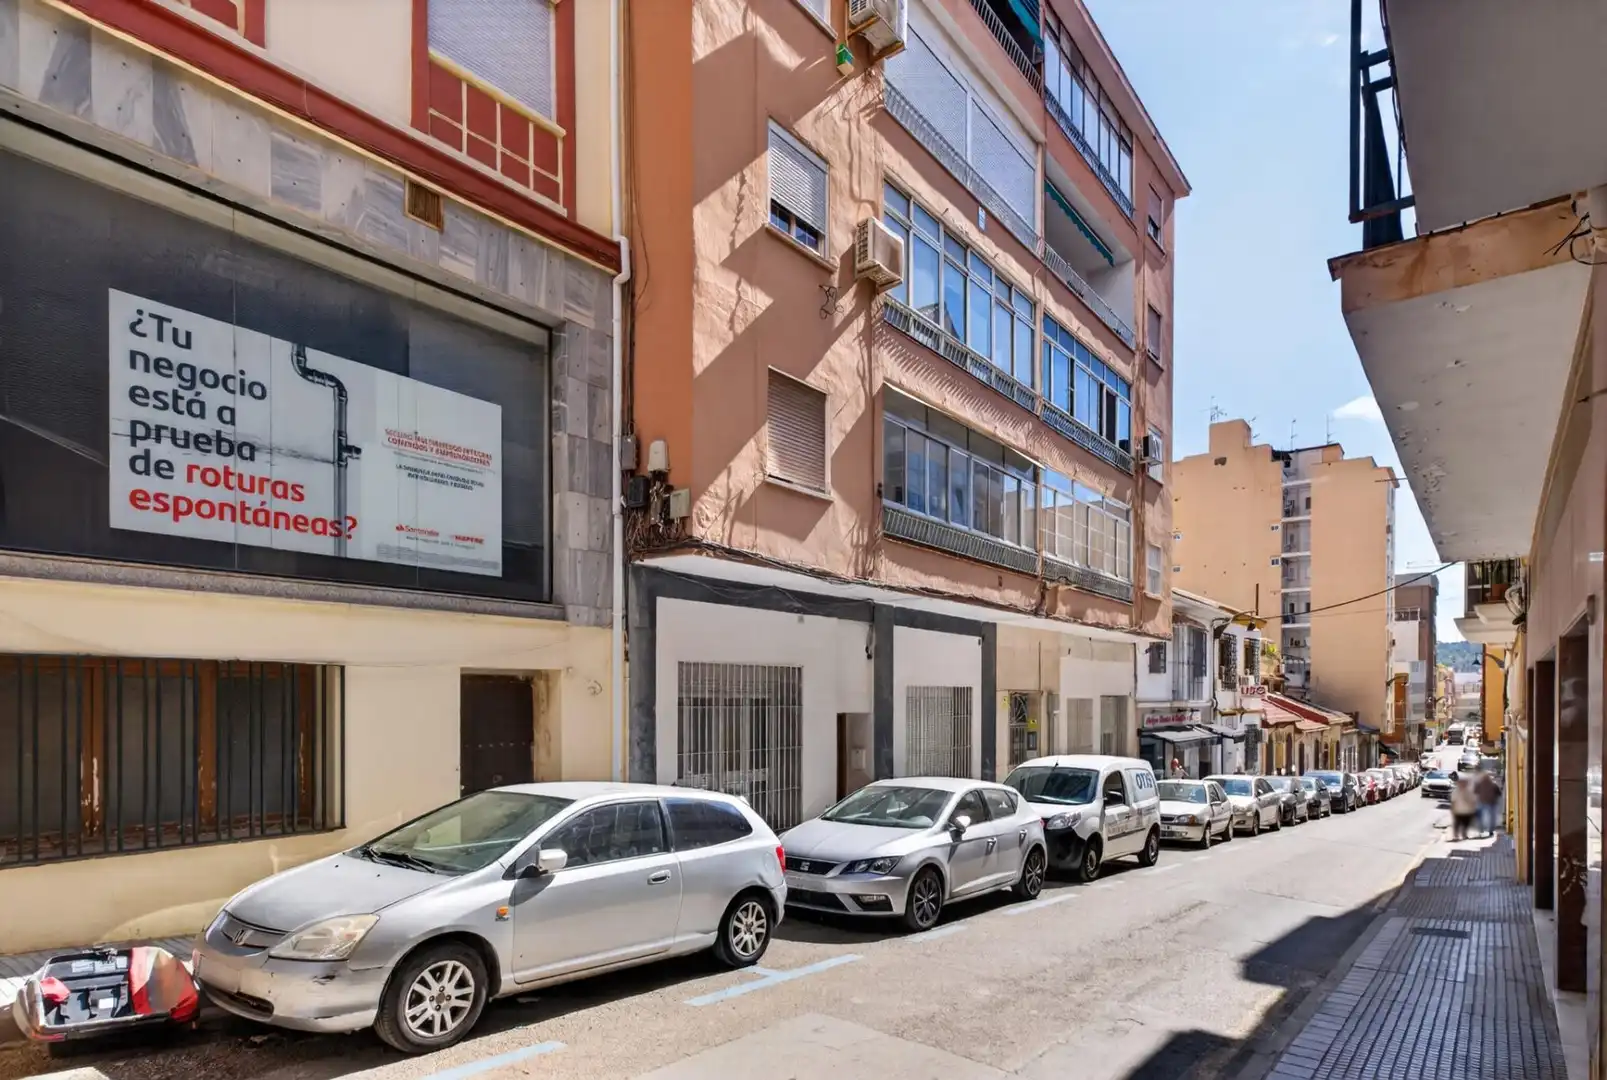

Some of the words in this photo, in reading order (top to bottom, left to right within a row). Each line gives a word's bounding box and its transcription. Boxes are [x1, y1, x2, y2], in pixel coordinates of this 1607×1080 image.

[129, 308, 193, 350] ¿Tu
[129, 349, 268, 401] negocio
[129, 384, 206, 420] está
[217, 405, 236, 427] a
[129, 420, 257, 462] prueba
[129, 449, 175, 480] de
[186, 463, 305, 504] roturas
[129, 489, 358, 540] espontáneas?
